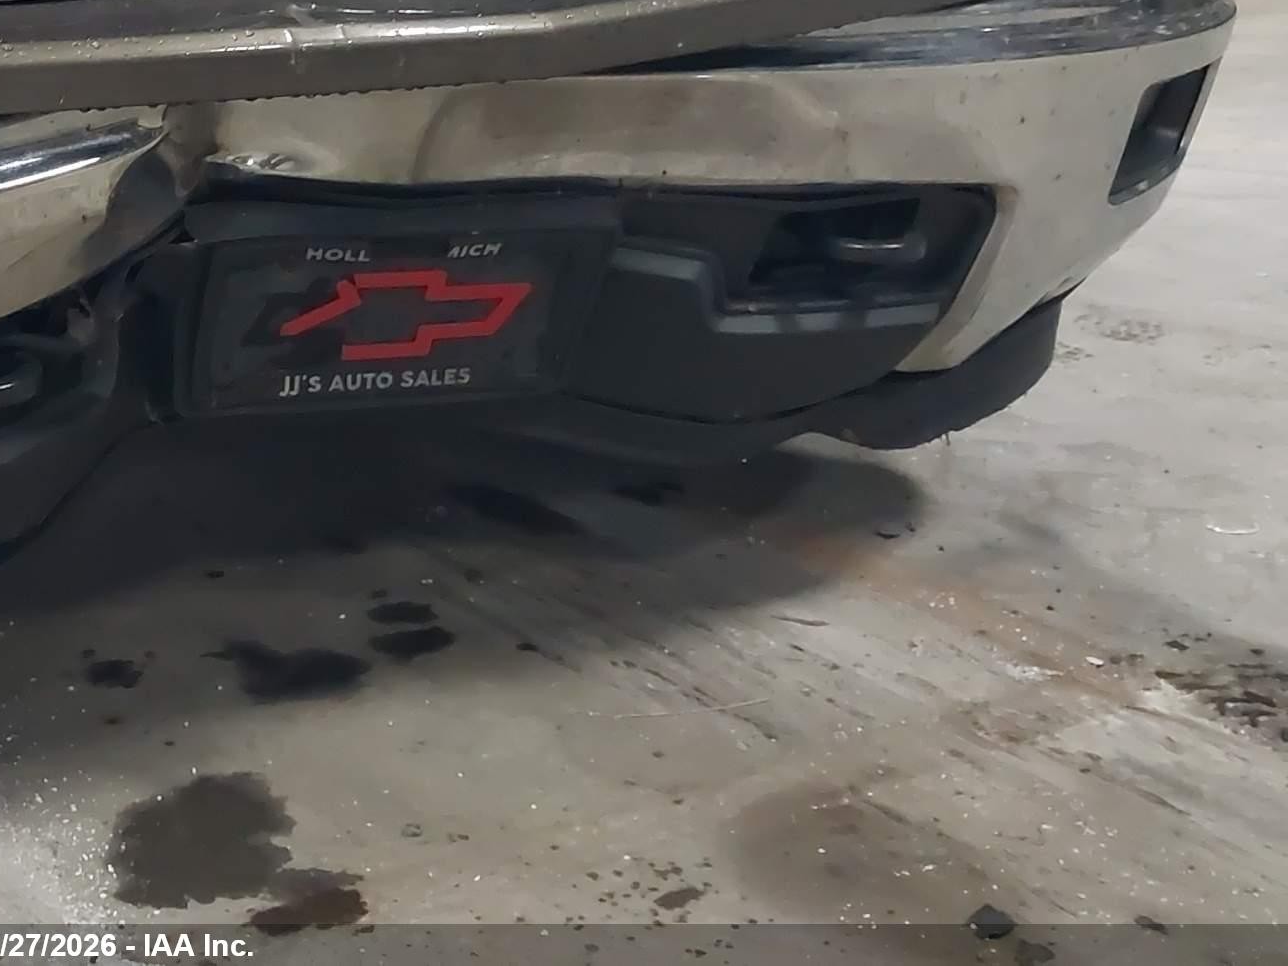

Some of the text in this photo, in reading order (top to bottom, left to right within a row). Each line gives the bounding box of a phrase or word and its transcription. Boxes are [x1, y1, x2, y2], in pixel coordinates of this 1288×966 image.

[279, 367, 472, 397] JJ'S AUTO SALES
